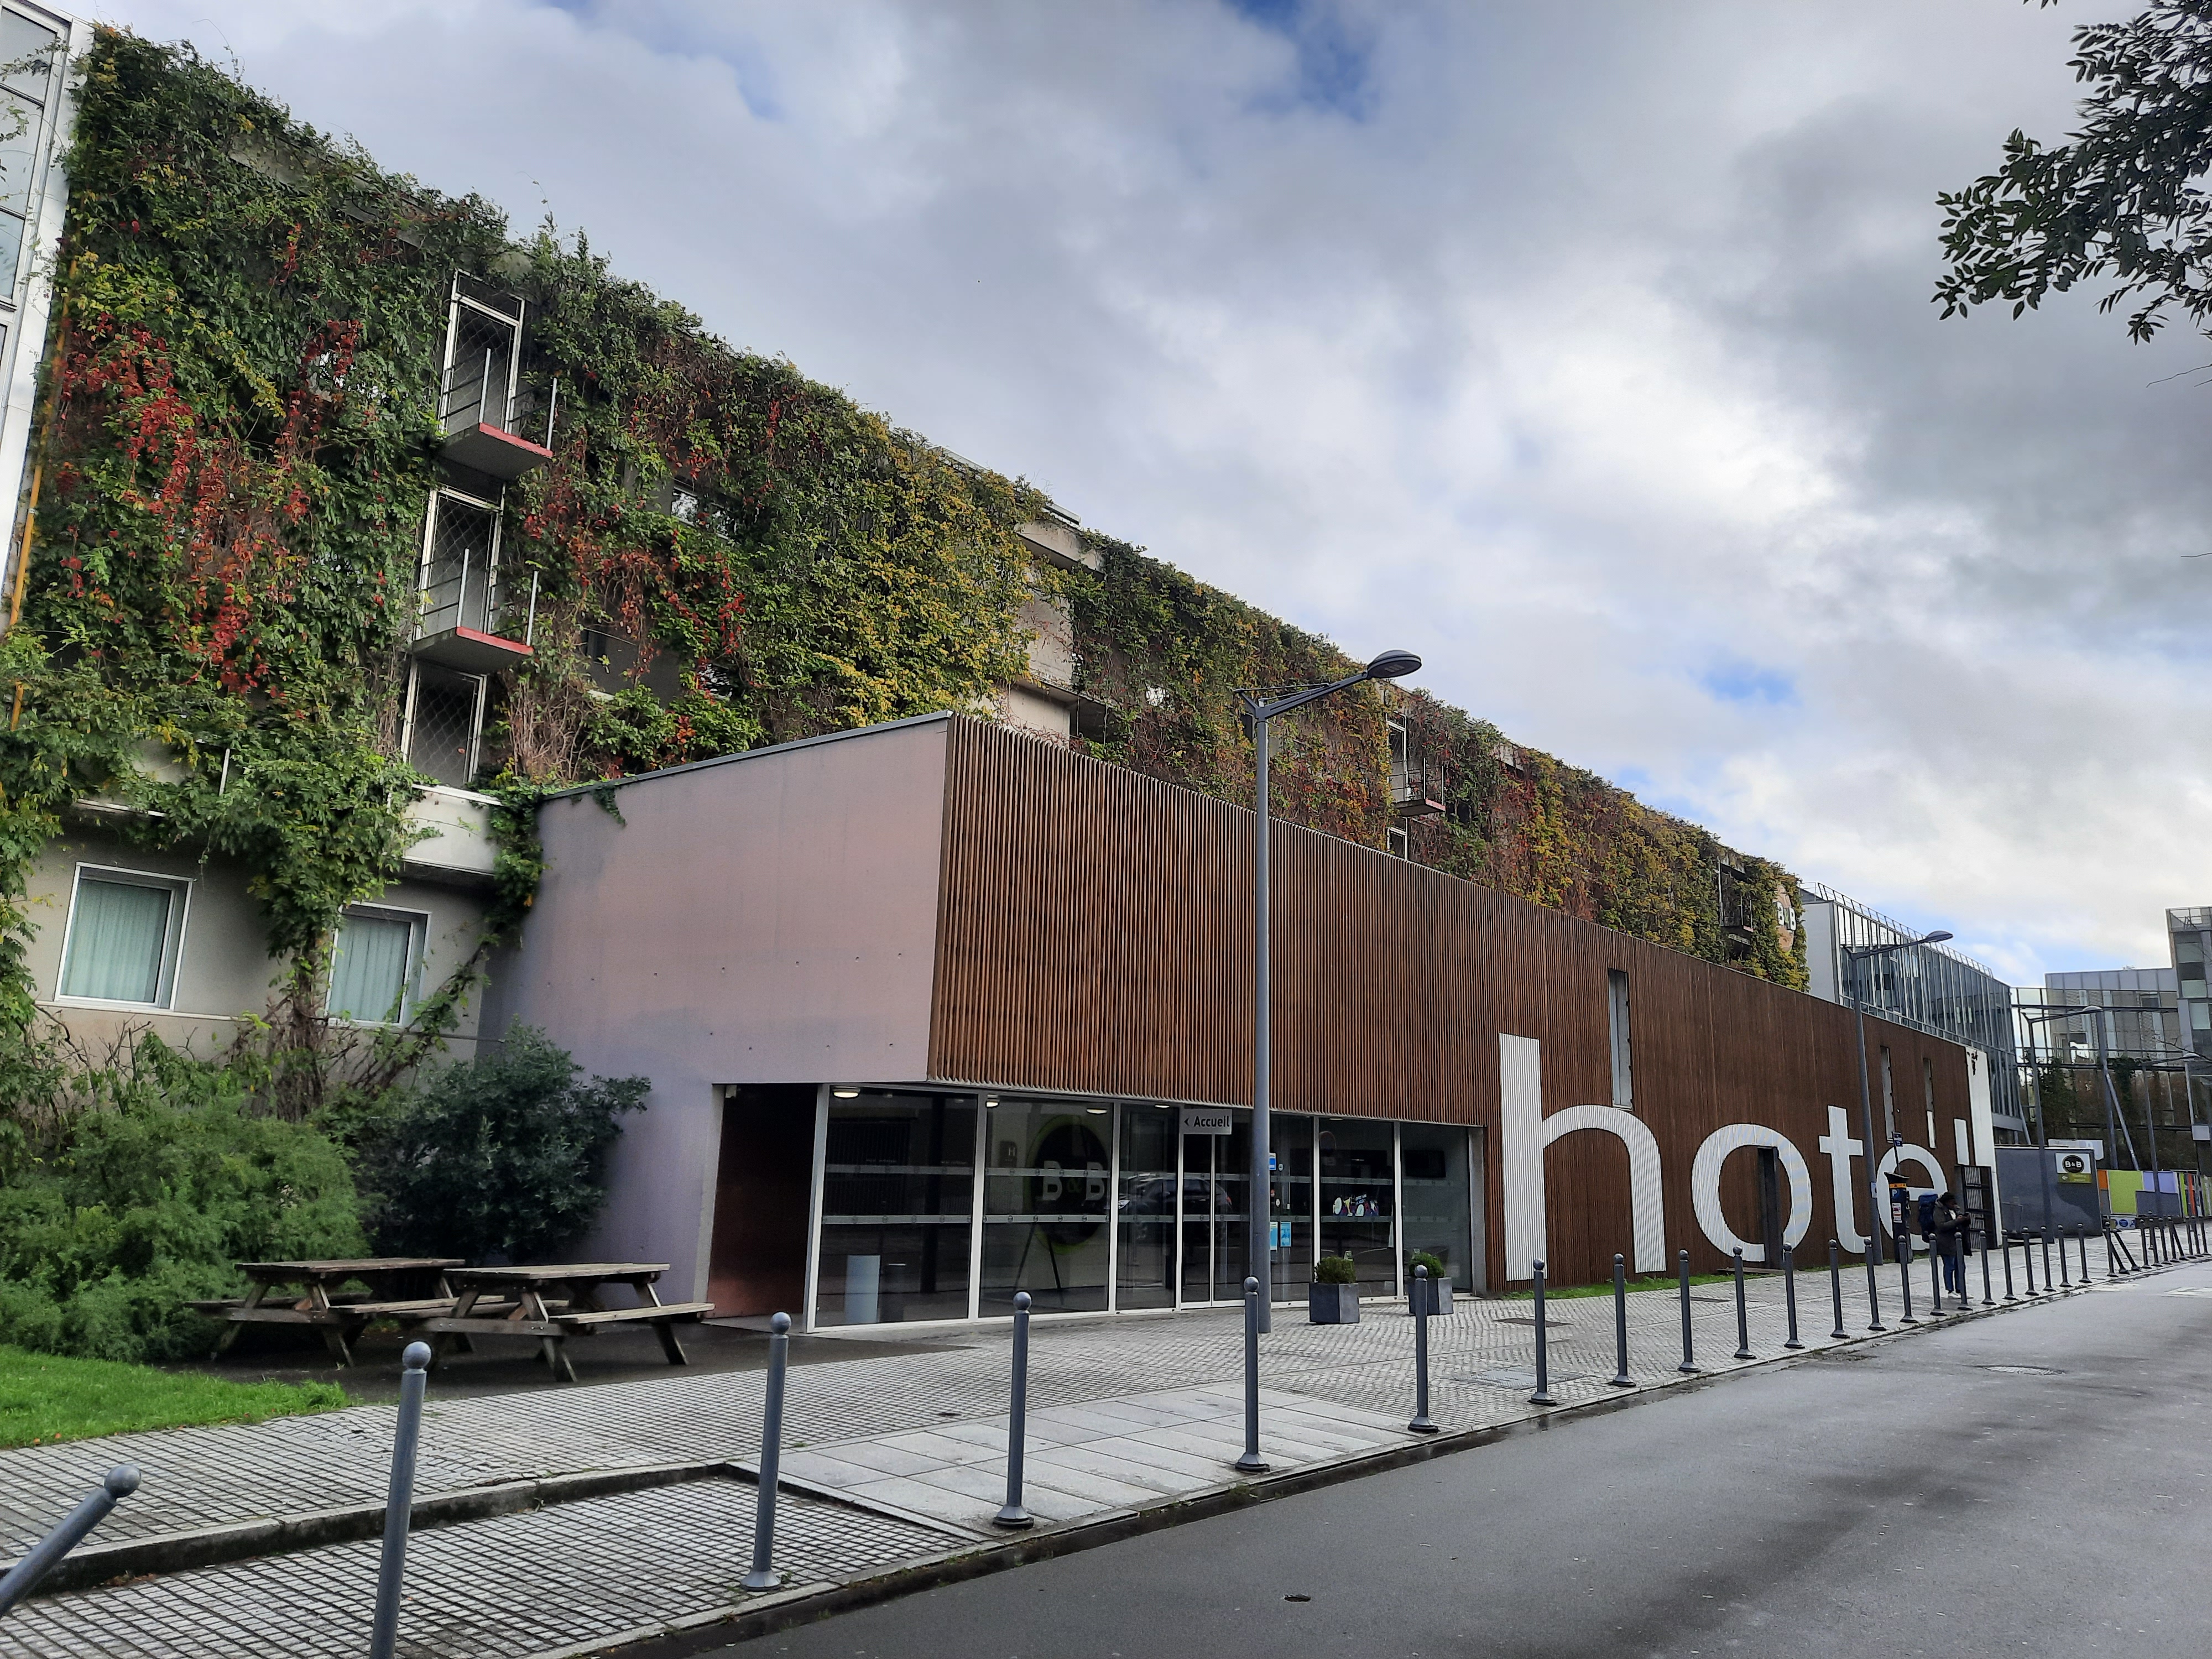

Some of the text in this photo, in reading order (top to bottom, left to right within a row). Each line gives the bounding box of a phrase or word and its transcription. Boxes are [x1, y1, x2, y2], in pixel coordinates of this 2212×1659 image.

[1193, 1115, 1230, 1127] Accueil
[1008, 1147, 1016, 1156] H
[1892, 1189, 1897, 1197] P
